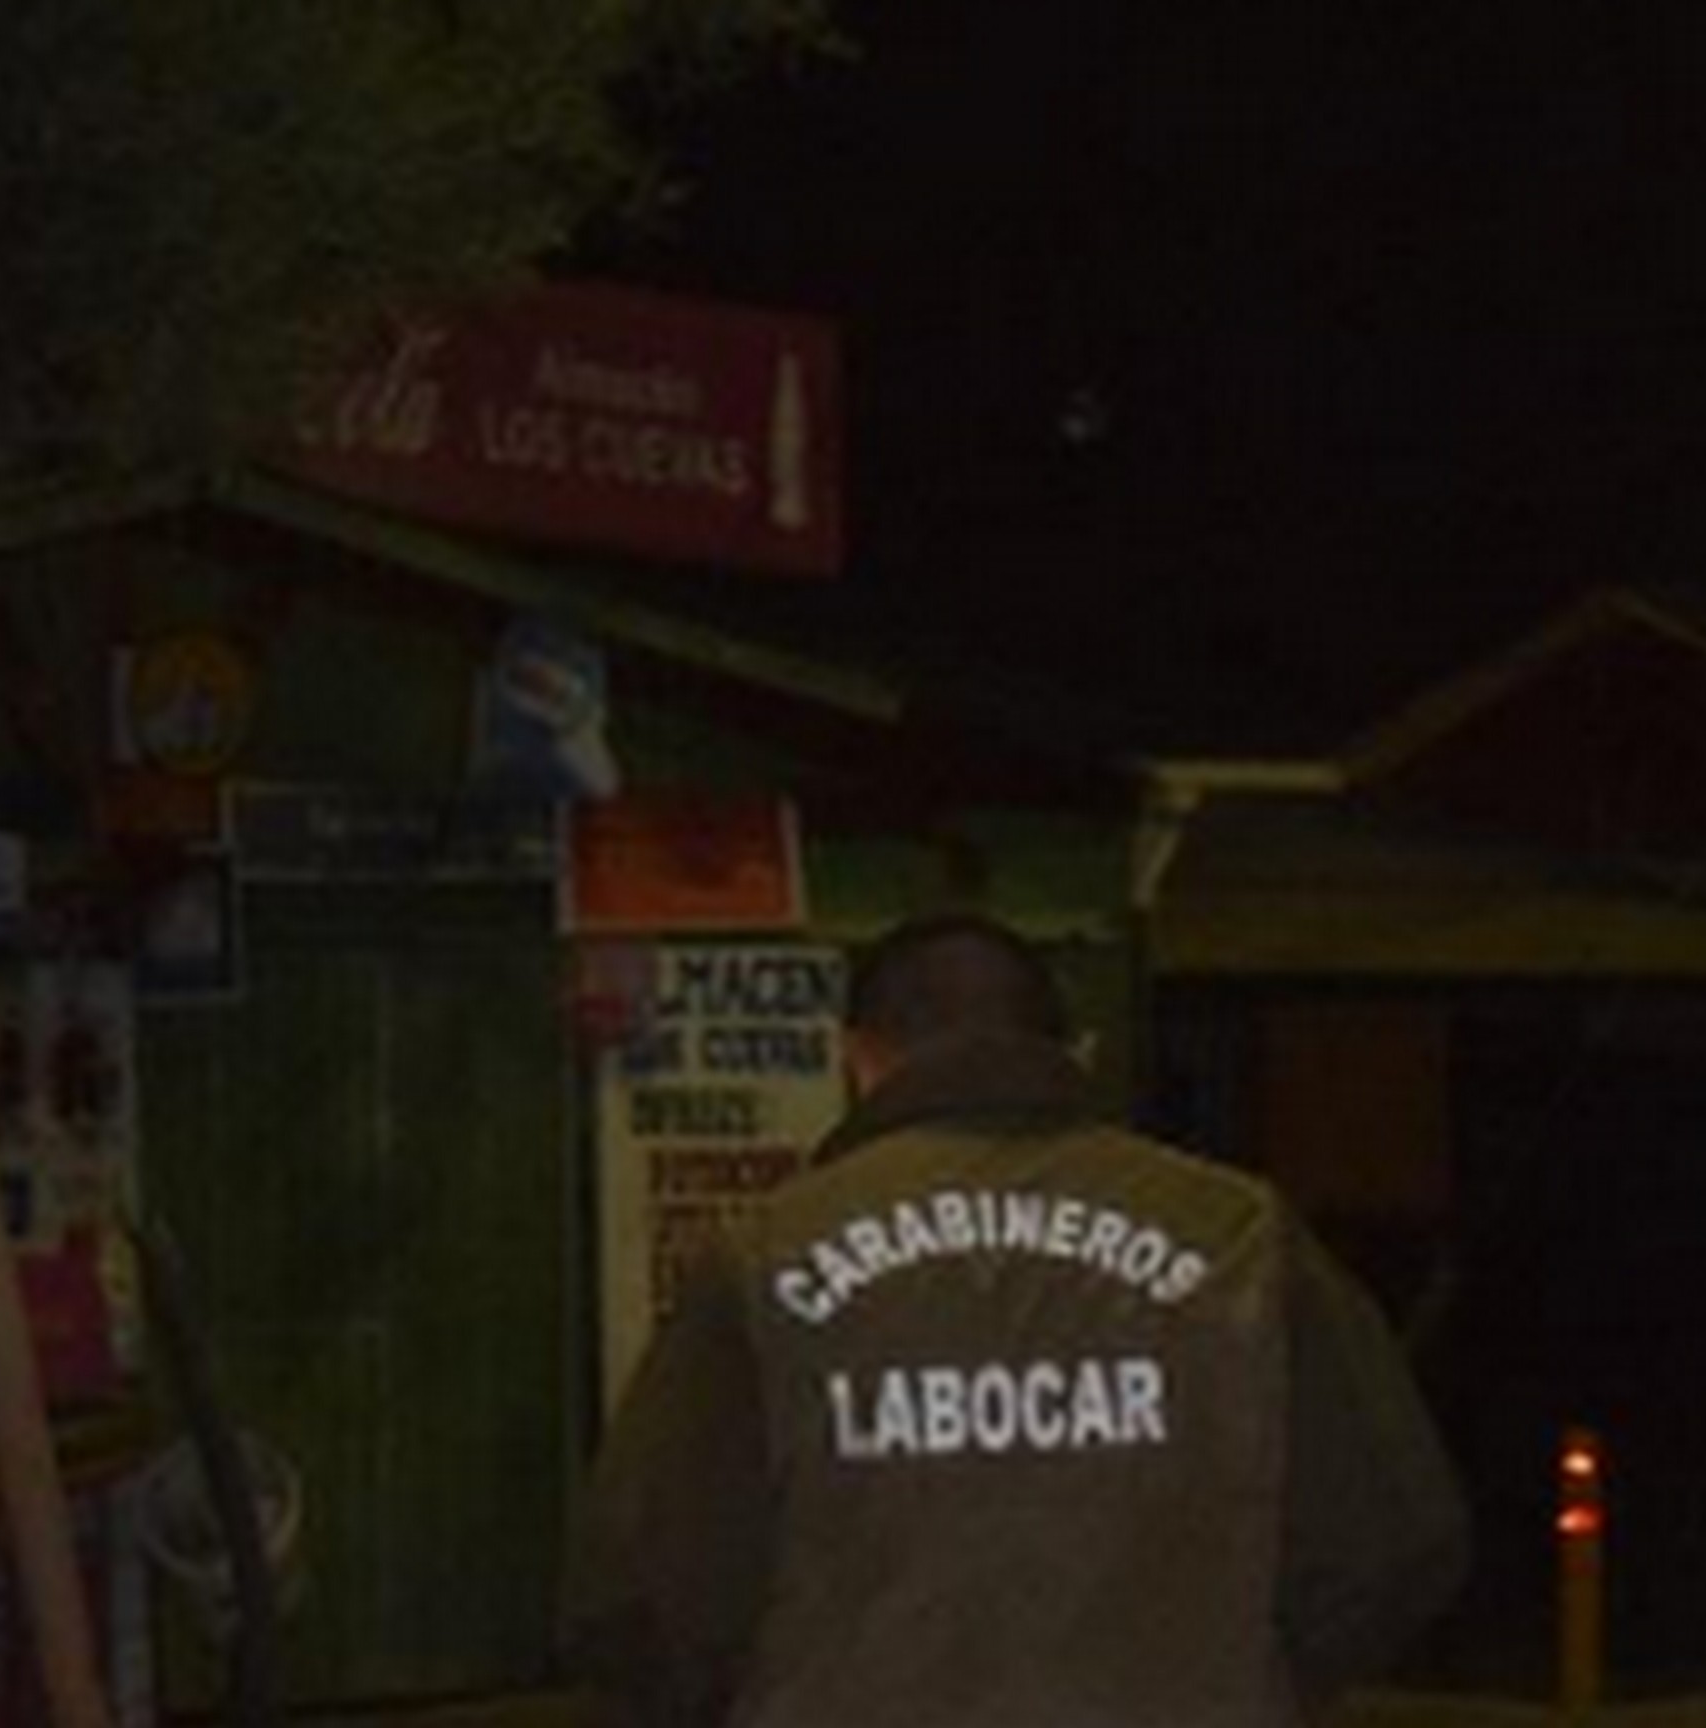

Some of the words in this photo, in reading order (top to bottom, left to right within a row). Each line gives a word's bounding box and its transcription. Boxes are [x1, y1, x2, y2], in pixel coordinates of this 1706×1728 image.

[478, 405, 567, 475] LOS
[582, 418, 754, 498] CUEVAS
[655, 955, 841, 1017] LMACEN
[774, 1190, 1210, 1325] CARABINEROS
[826, 1357, 1168, 1461] LABOCAR
